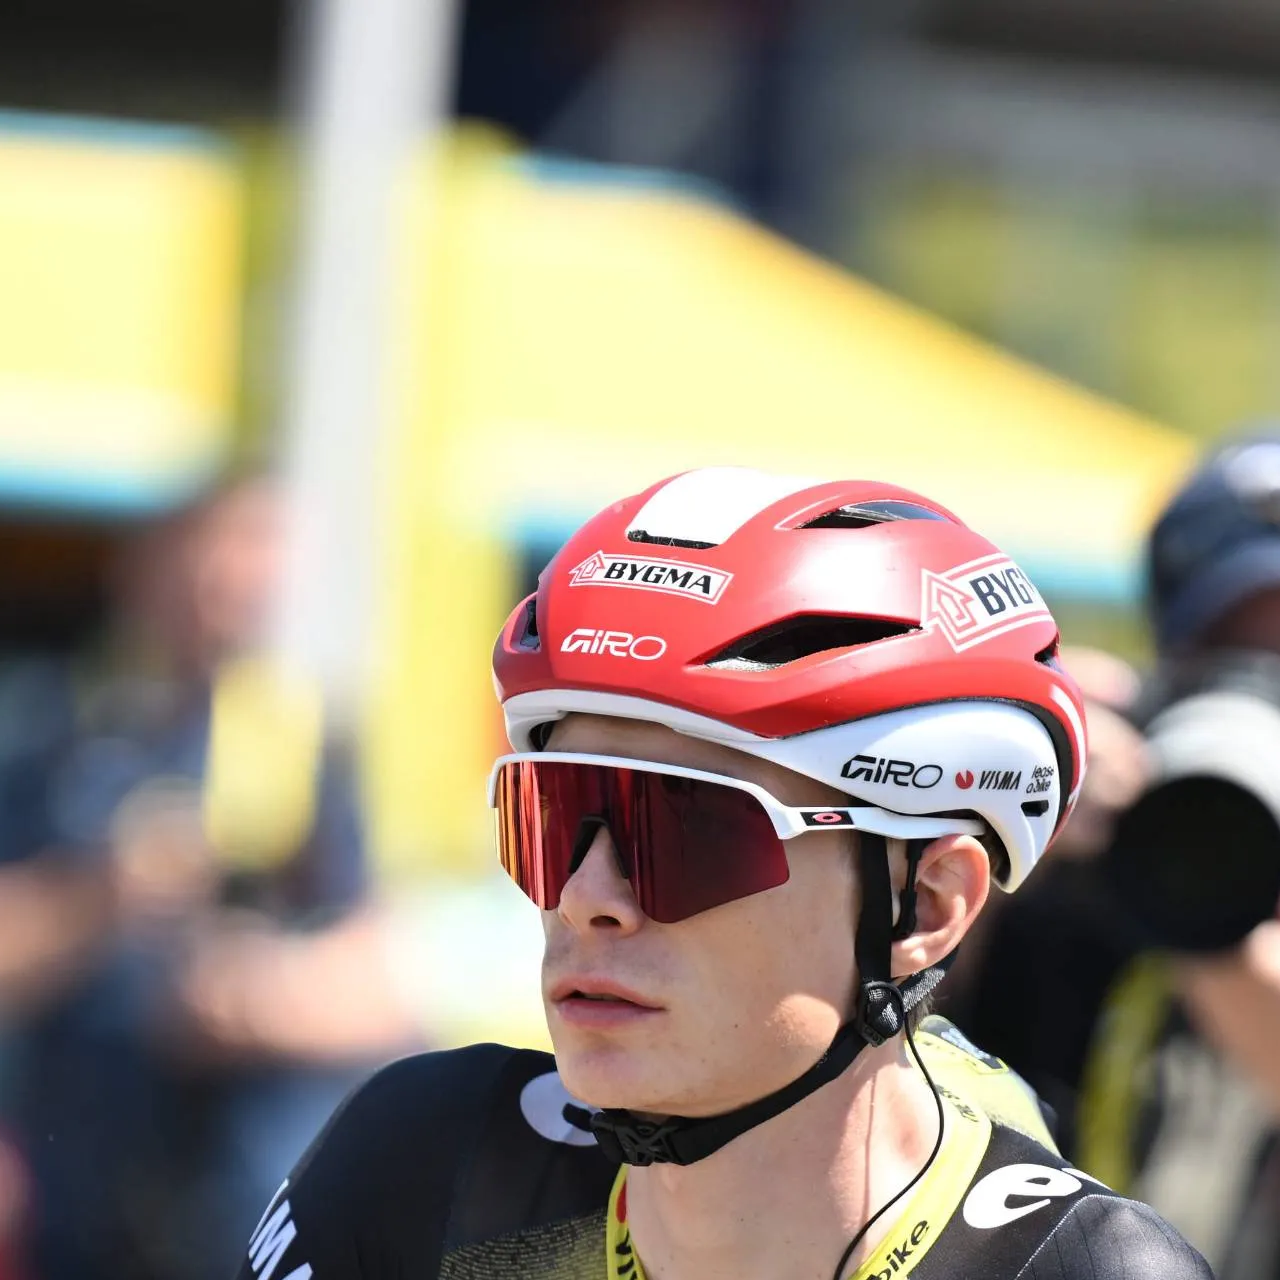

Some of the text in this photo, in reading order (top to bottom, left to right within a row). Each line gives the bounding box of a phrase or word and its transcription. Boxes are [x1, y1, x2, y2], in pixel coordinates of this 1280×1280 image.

[604, 562, 712, 595] BYGMA
[560, 628, 668, 661] GIRO
[840, 754, 943, 789] GIRO
[978, 770, 1022, 790] VISMA
